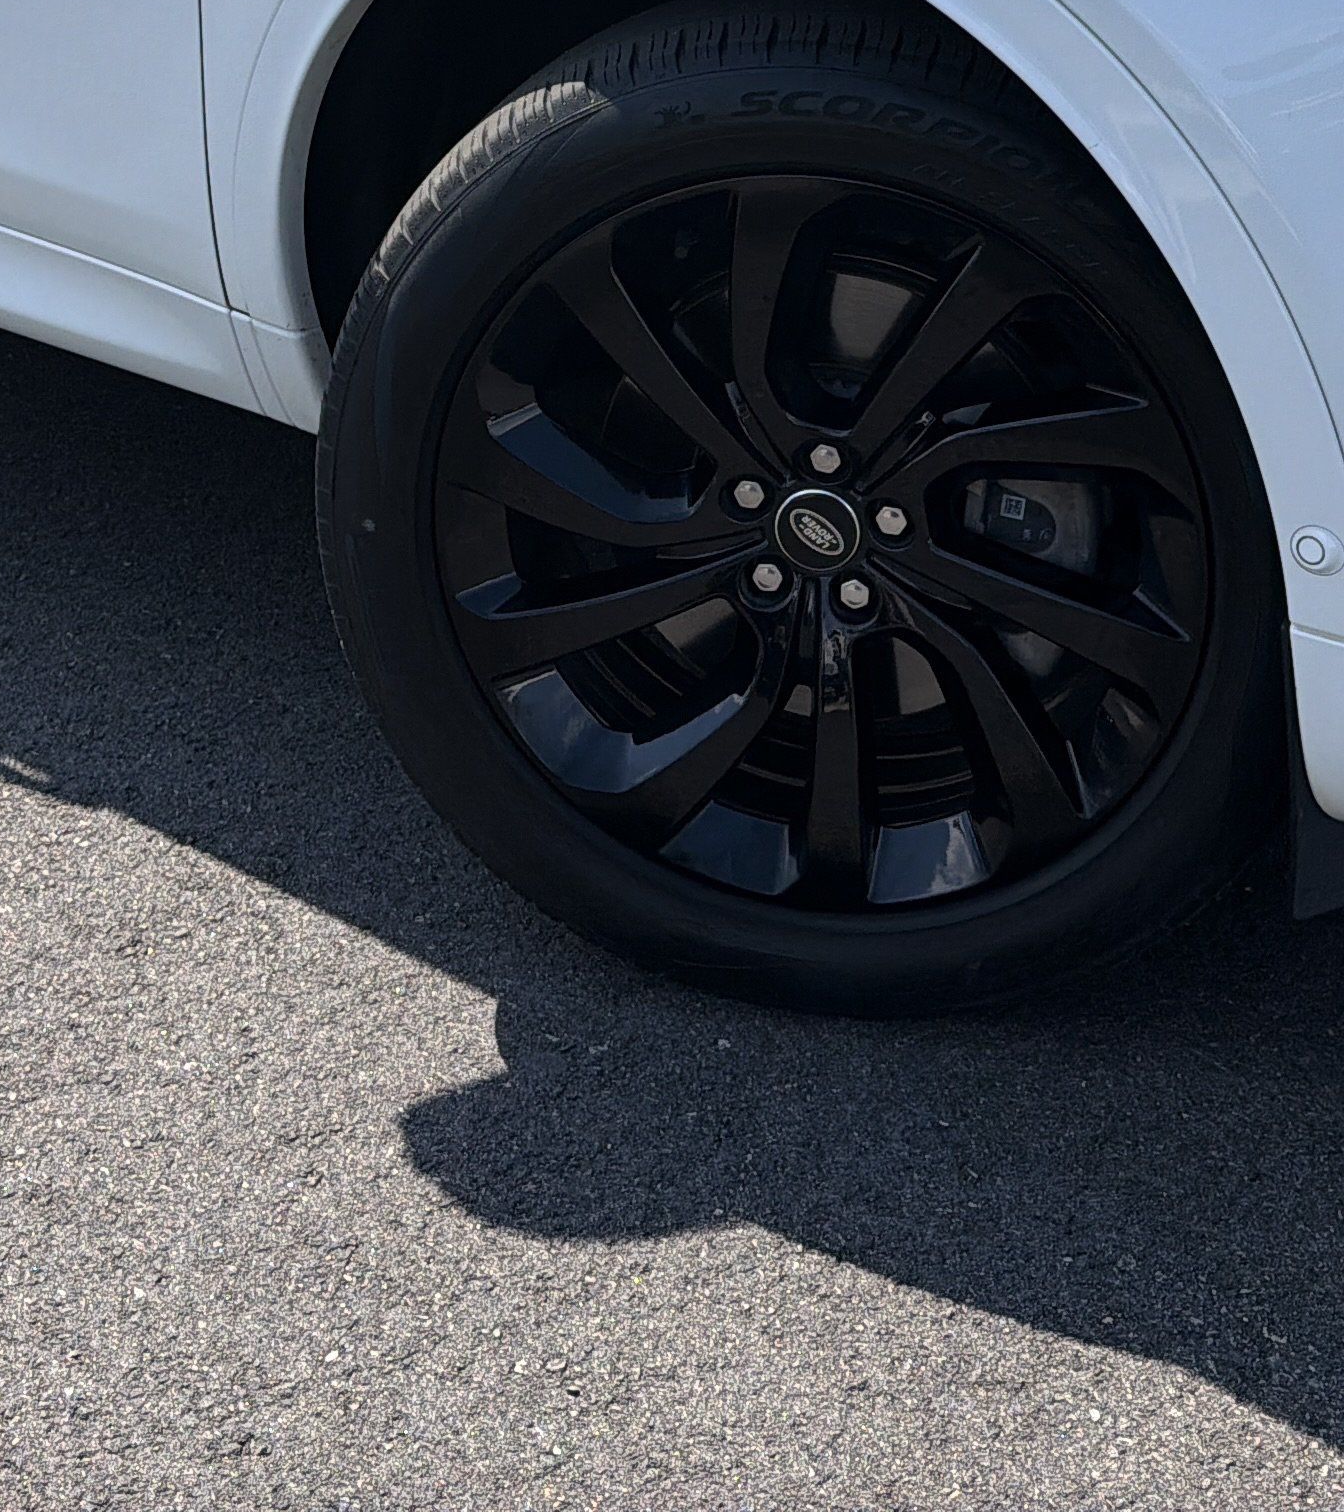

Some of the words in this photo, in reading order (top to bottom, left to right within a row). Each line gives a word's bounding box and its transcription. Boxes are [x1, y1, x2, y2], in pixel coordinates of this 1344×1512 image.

[732, 88, 1056, 180] SCORPIO
[801, 514, 834, 541] ROVER
[803, 527, 830, 549] LAND
